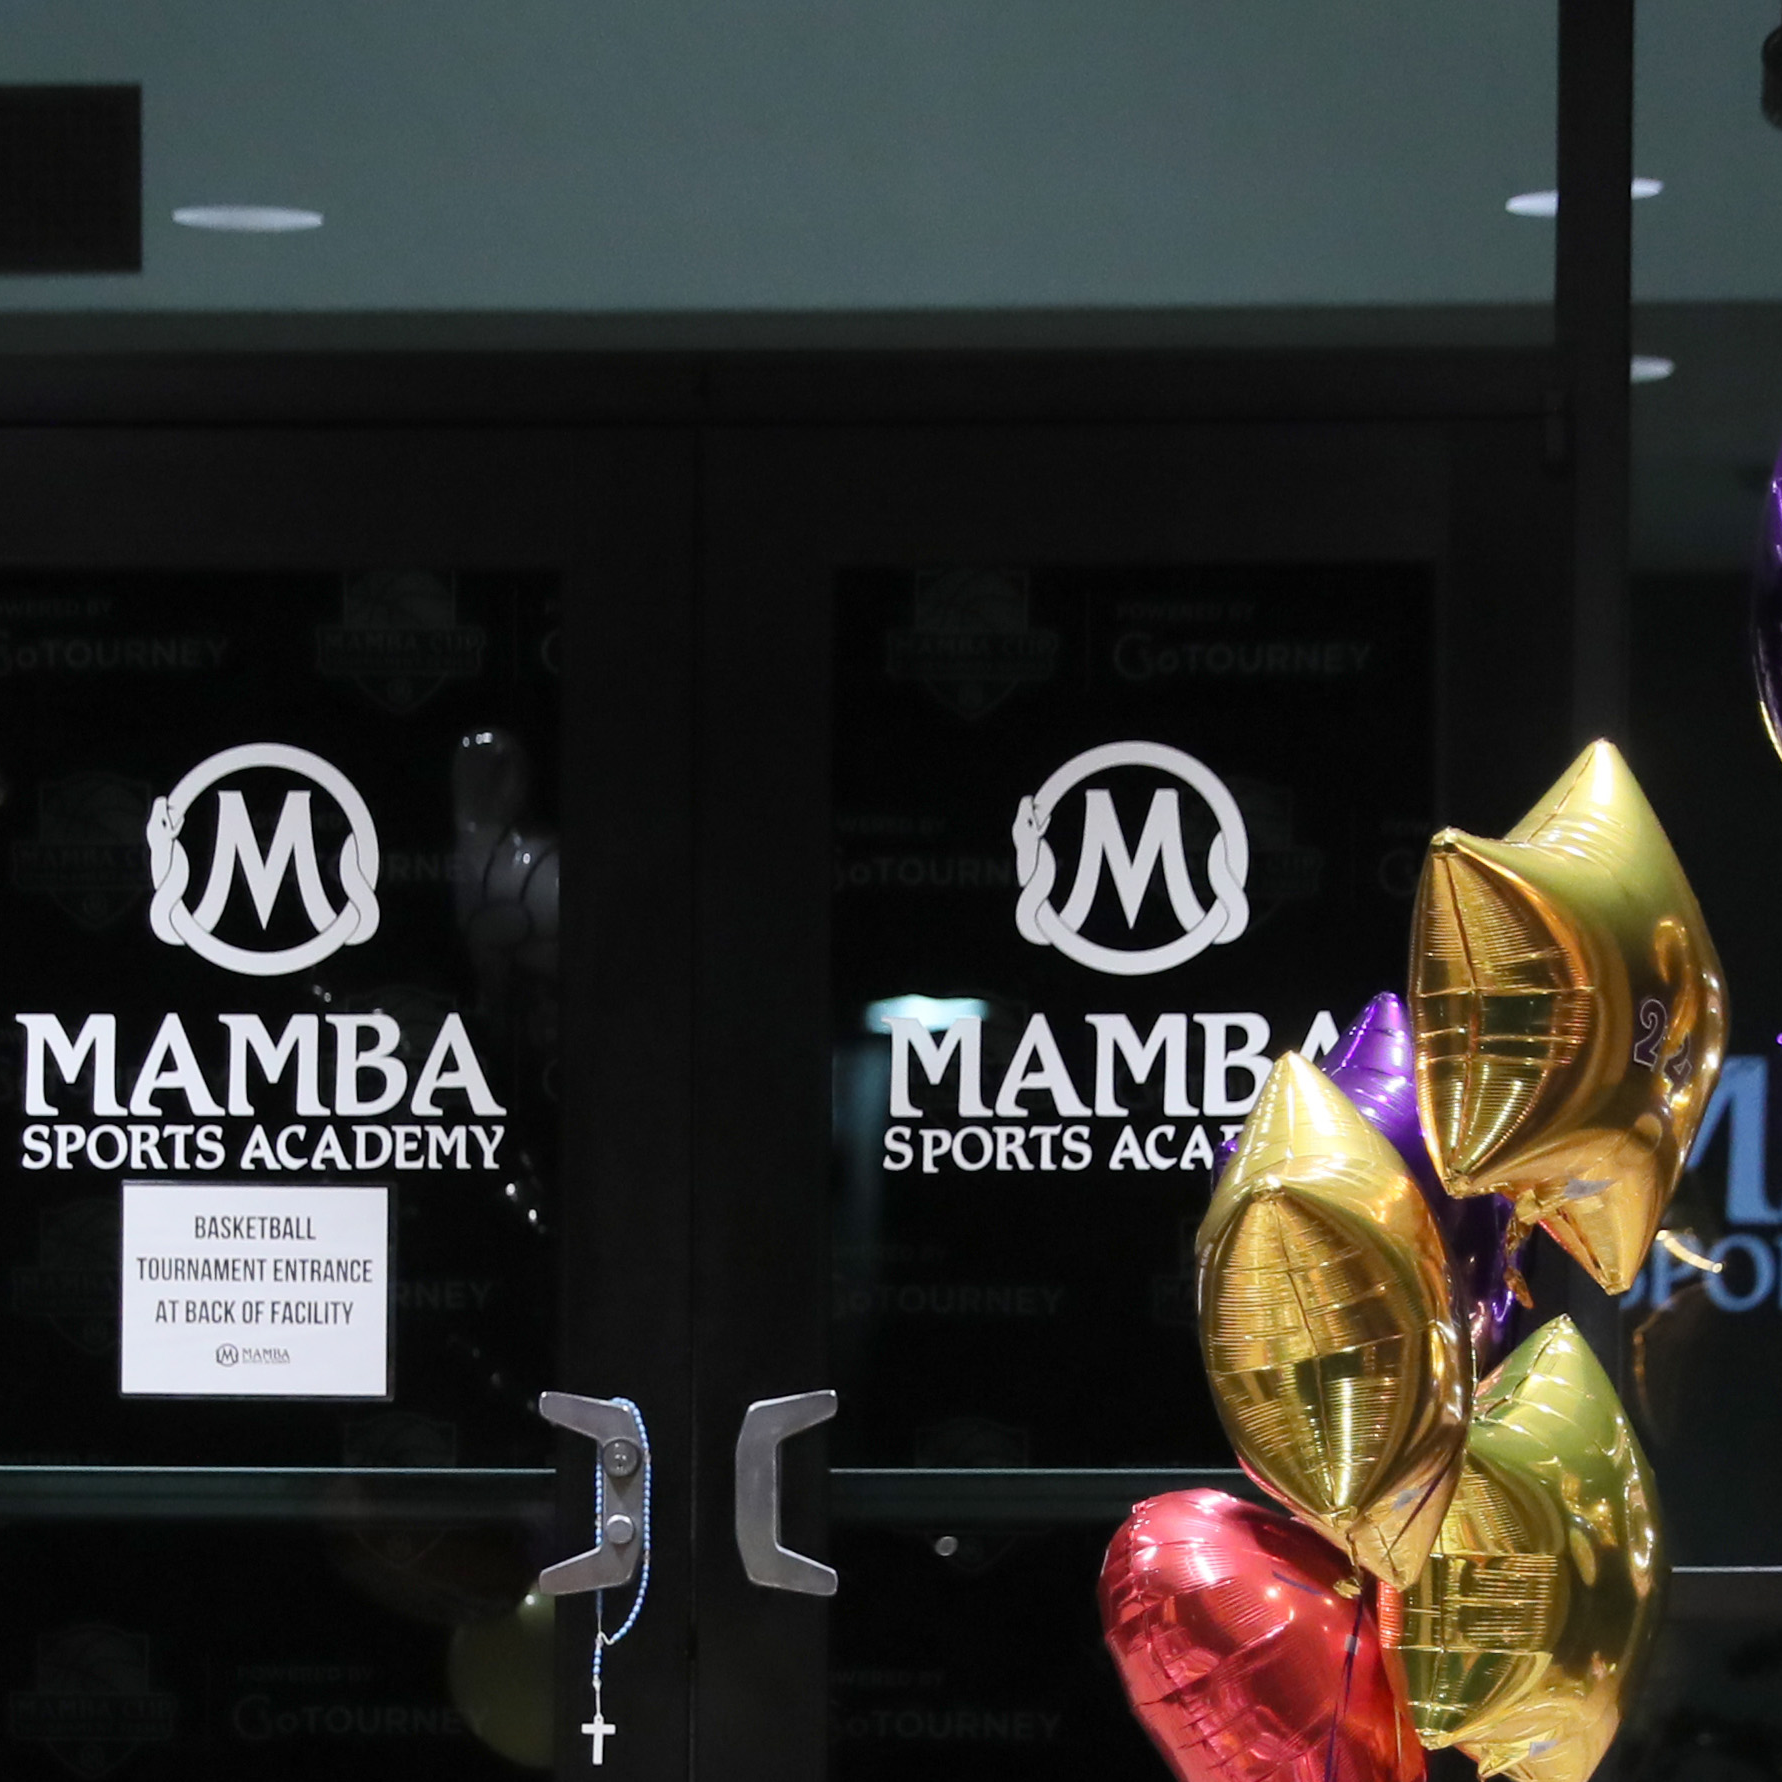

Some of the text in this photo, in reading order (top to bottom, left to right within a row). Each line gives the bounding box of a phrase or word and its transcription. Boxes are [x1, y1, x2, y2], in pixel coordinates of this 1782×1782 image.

[16, 1011, 506, 1117] MAMBA
[881, 1012, 1340, 1118] MAMB
[21, 1124, 505, 1171] SPORTS ACADEMY
[883, 1124, 1093, 1174] SPORTS
[194, 1216, 317, 1240] BASKETBALL
[137, 1257, 373, 1283] TOURNAMENT ENTRANCE
[155, 1300, 354, 1325] AT BACK OF FACILITY
